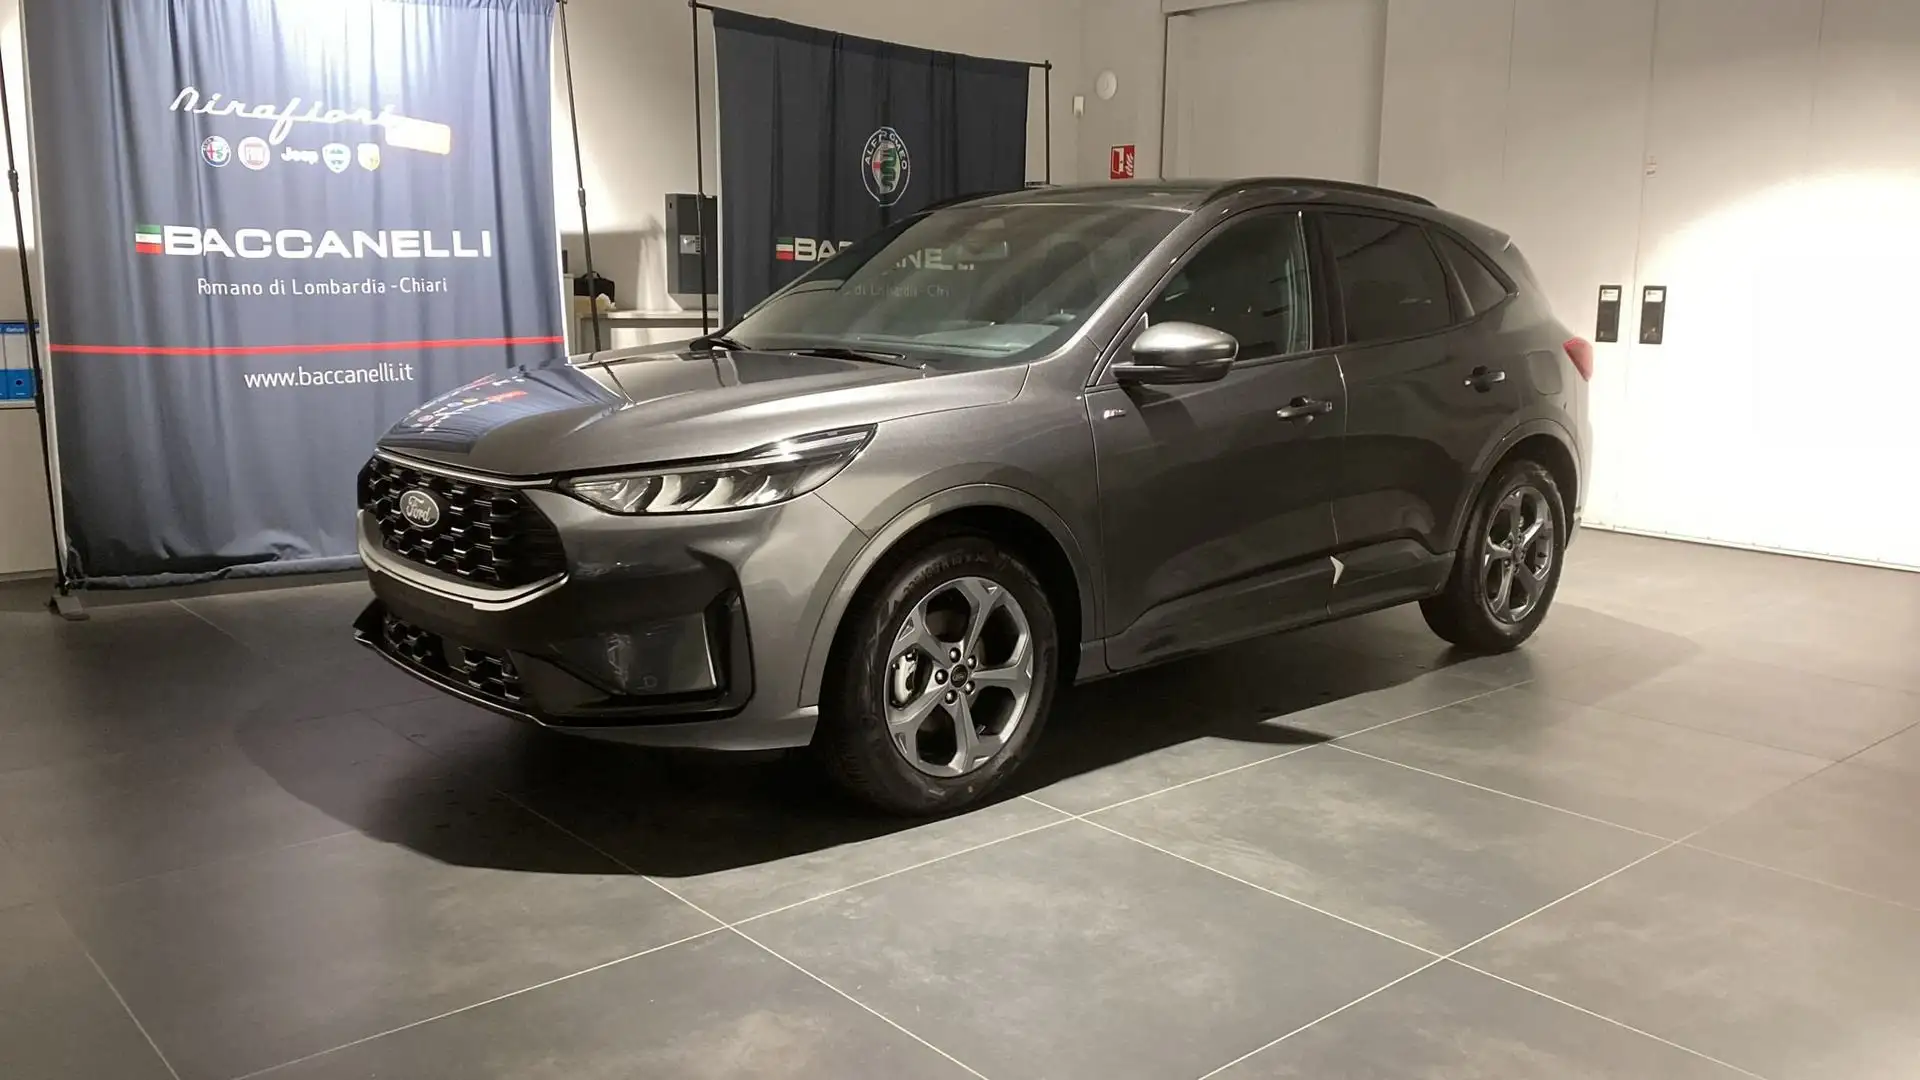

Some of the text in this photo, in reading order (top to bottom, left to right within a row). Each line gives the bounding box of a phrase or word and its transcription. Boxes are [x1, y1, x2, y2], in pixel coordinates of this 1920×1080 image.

[164, 226, 491, 258] BACCANELLI
[197, 278, 263, 296] Romano
[269, 278, 286, 295] di
[292, 277, 386, 295] Lombardia
[244, 362, 414, 388] www.baccanelli.it
[406, 495, 431, 522] Ford
